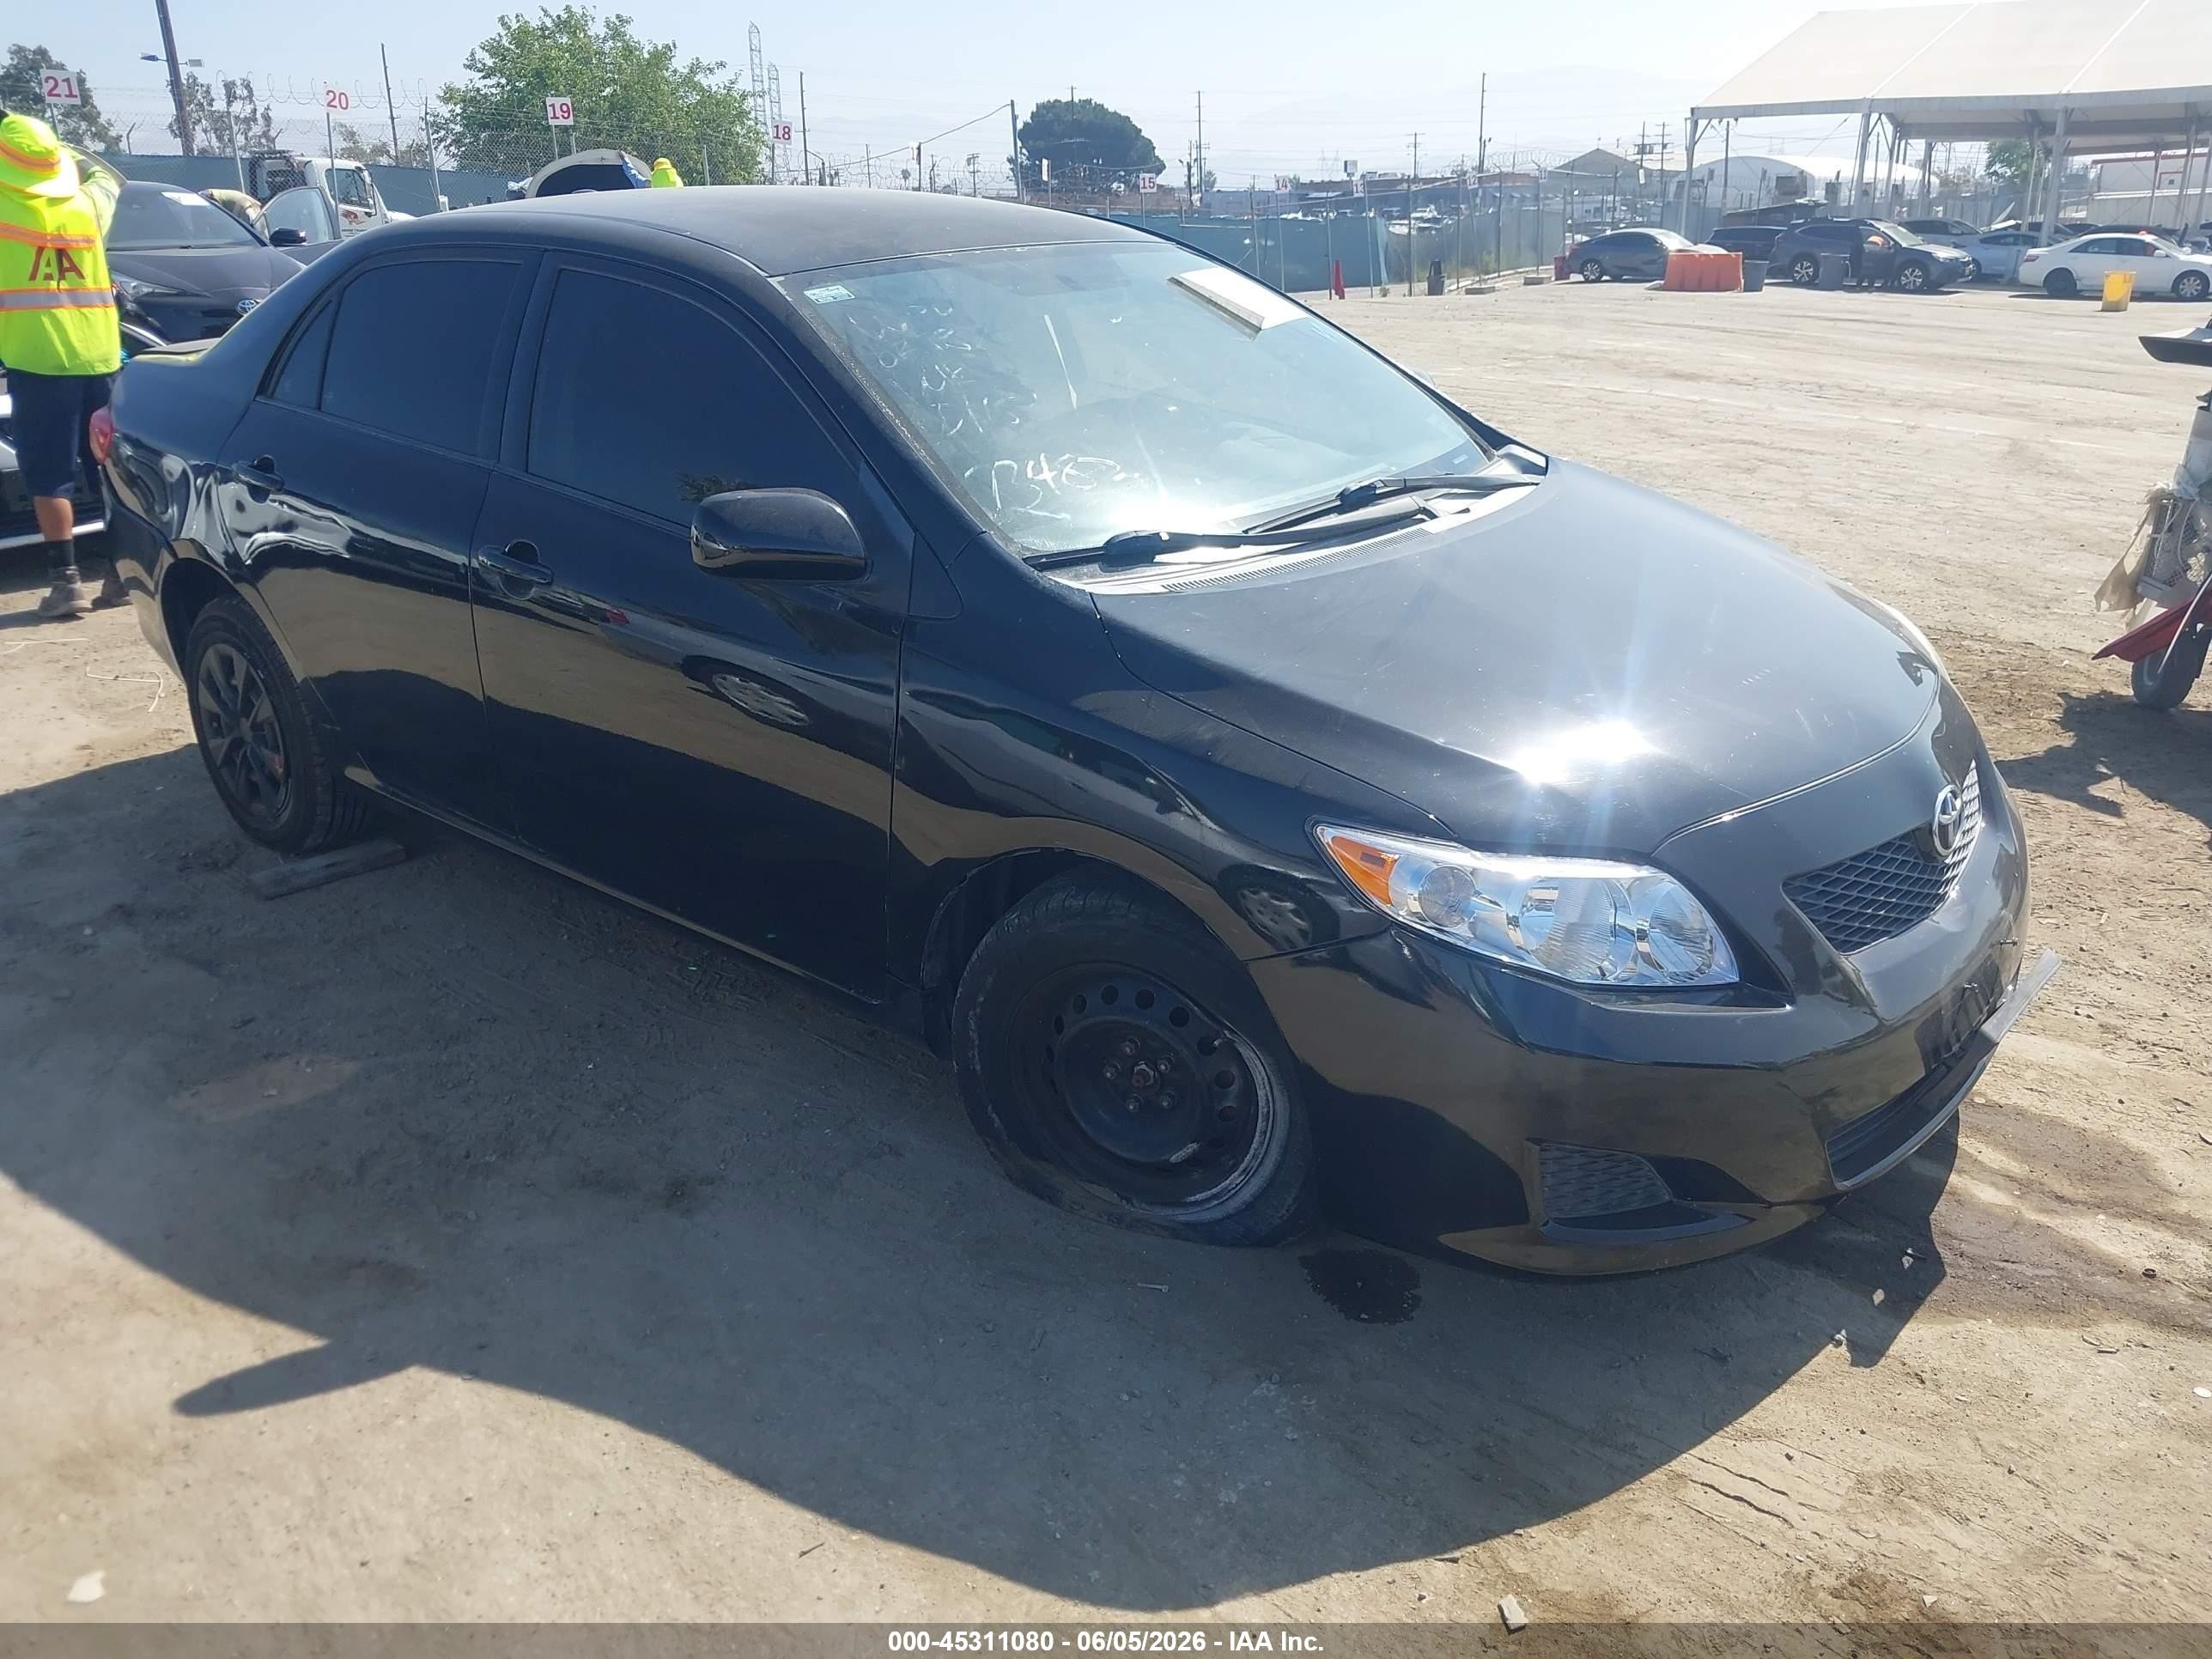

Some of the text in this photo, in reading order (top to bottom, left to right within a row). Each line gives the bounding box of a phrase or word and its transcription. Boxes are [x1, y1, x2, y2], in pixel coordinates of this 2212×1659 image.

[44, 76, 78, 98] 21
[326, 89, 349, 110] 20
[549, 102, 571, 119] 19
[773, 125, 791, 141] 18
[1141, 177, 1156, 189] 15
[1275, 178, 1288, 191] 14
